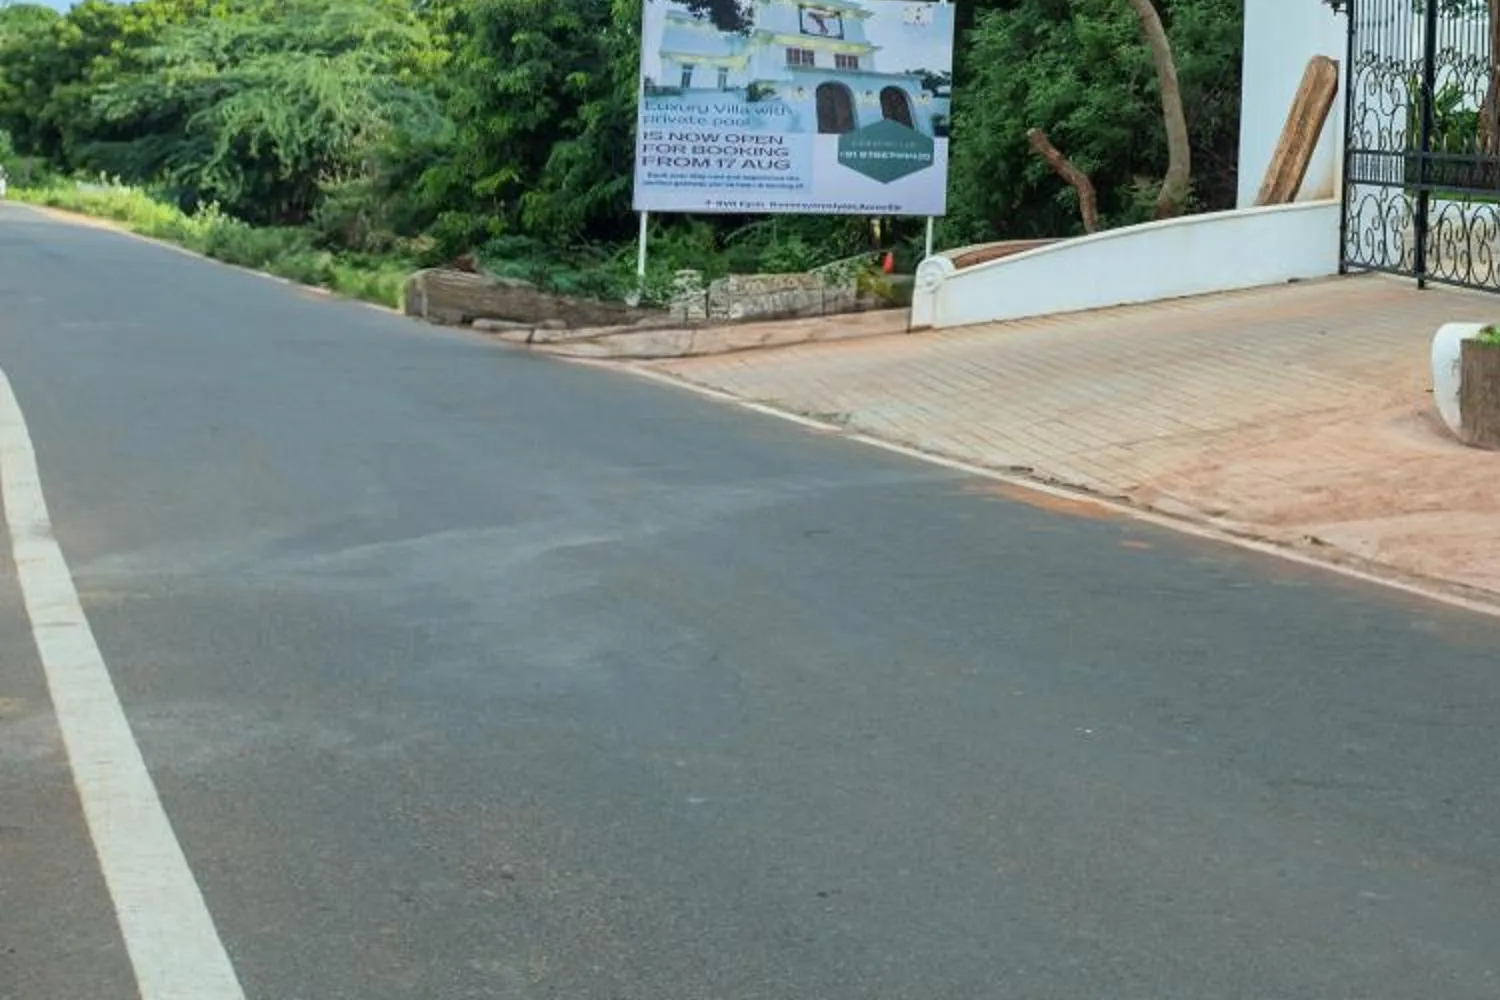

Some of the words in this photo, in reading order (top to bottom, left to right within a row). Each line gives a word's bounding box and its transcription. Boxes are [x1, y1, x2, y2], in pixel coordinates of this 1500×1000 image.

[645, 100, 709, 115] Luxury
[713, 103, 749, 114] Villa
[753, 104, 793, 116] with
[643, 114, 707, 126] private
[712, 117, 750, 128] pool
[643, 131, 662, 141] IS
[668, 131, 720, 143] NOW
[725, 133, 783, 145] OPEN
[642, 143, 686, 155] FOR
[691, 145, 789, 157] BOOKING
[642, 155, 711, 168] FROM
[716, 158, 737, 169] 17
[741, 159, 791, 171] AUG
